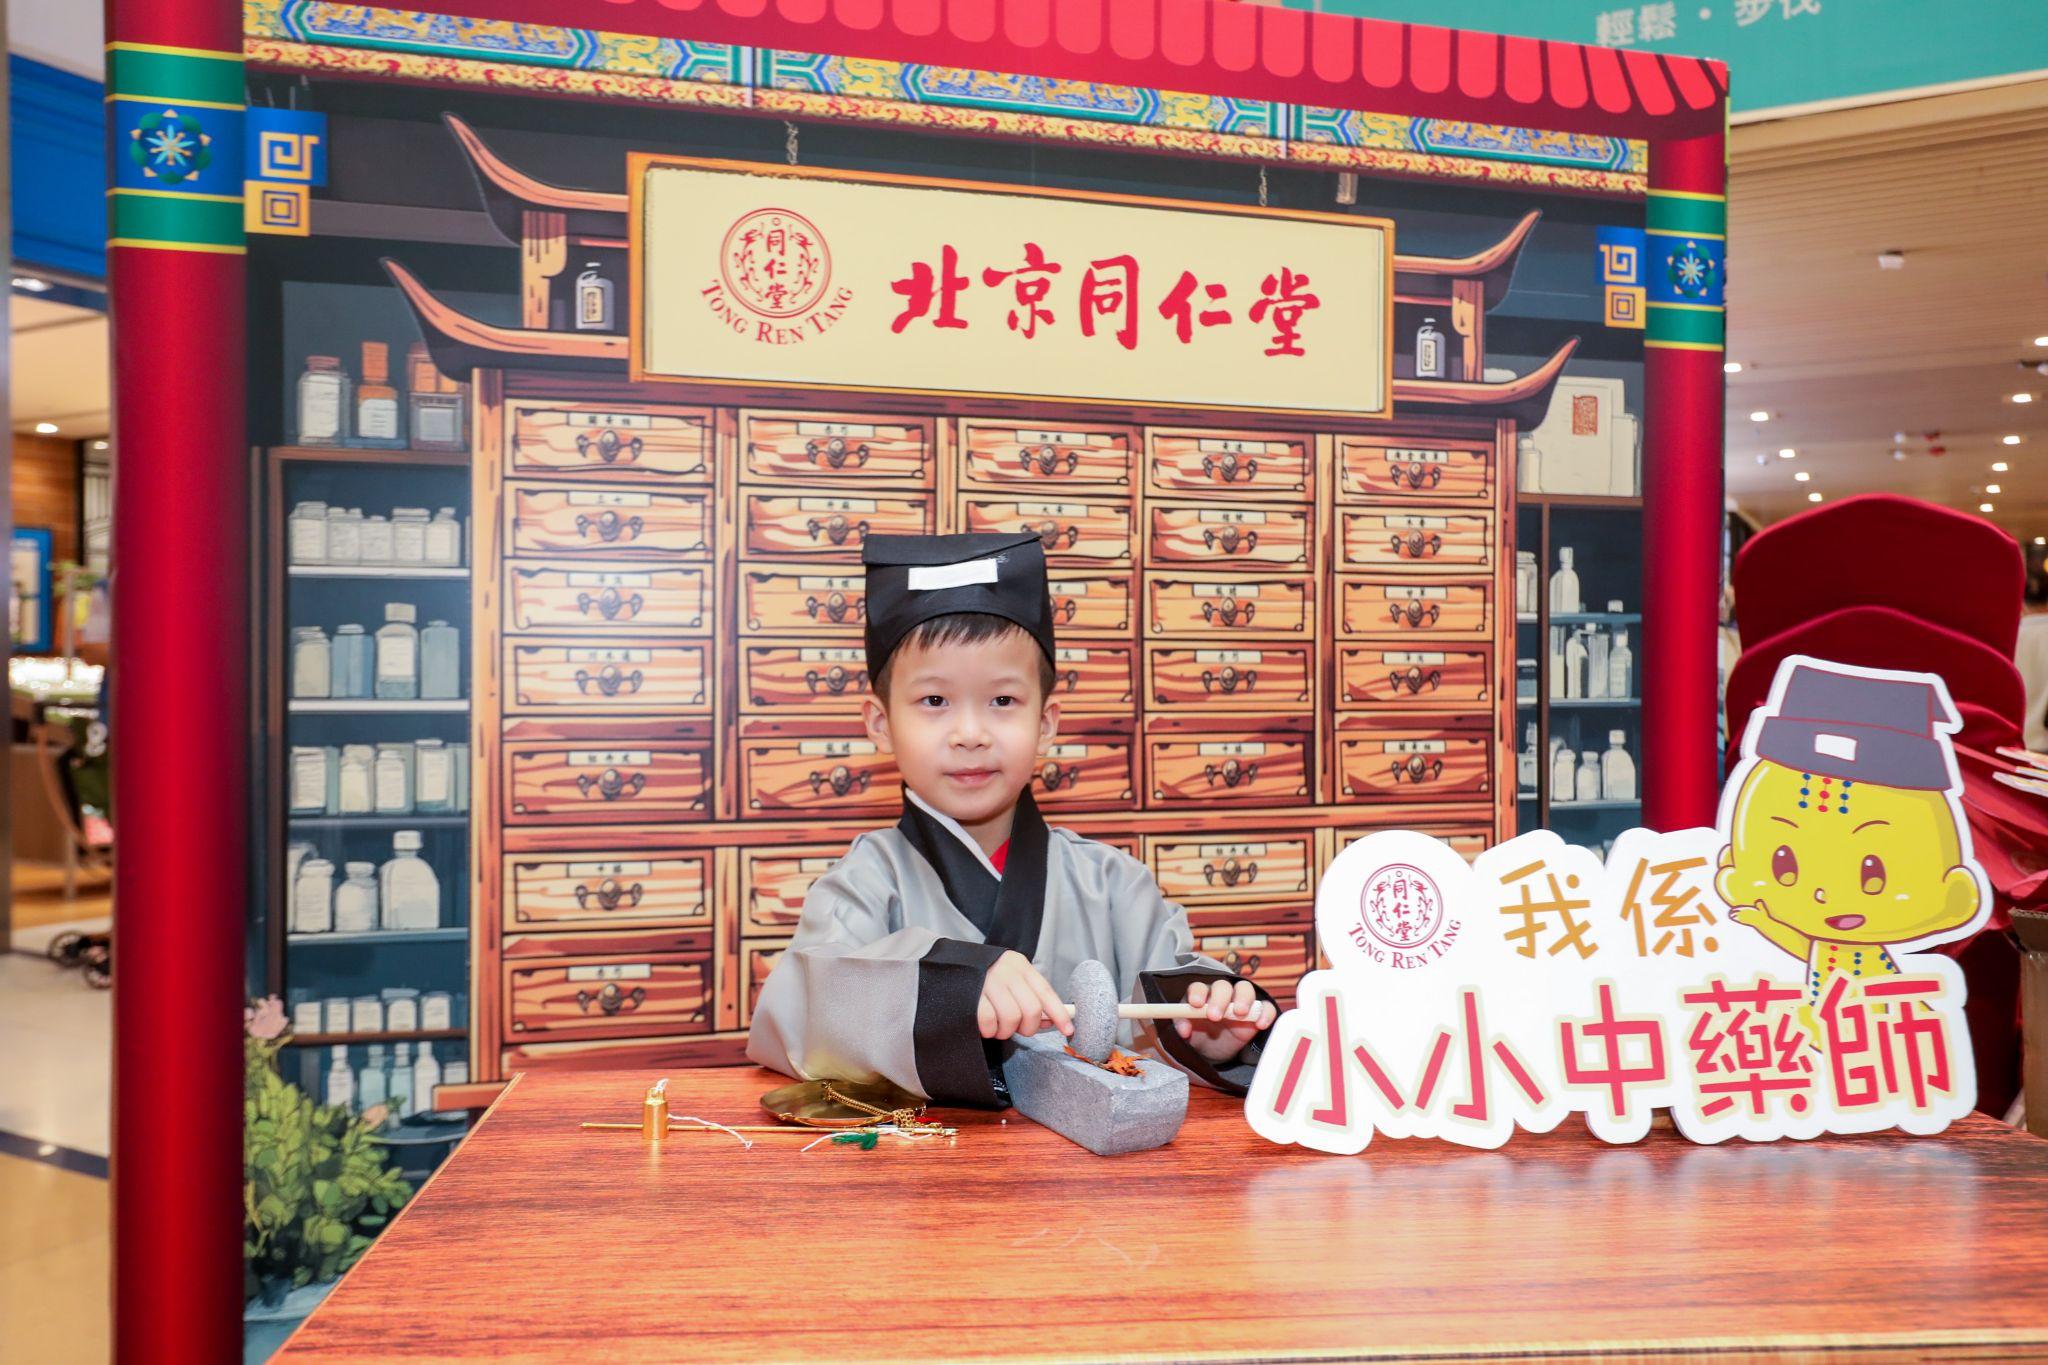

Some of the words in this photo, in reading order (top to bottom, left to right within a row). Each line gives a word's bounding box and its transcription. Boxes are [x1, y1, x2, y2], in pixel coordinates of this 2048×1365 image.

[763, 229, 788, 309] 同仁堂
[890, 242, 1321, 358] 北京同仁堂
[1393, 878, 1412, 942] 同仁堂
[1497, 855, 1718, 958] 我係
[1272, 978, 1951, 1128] 小小中藥師
